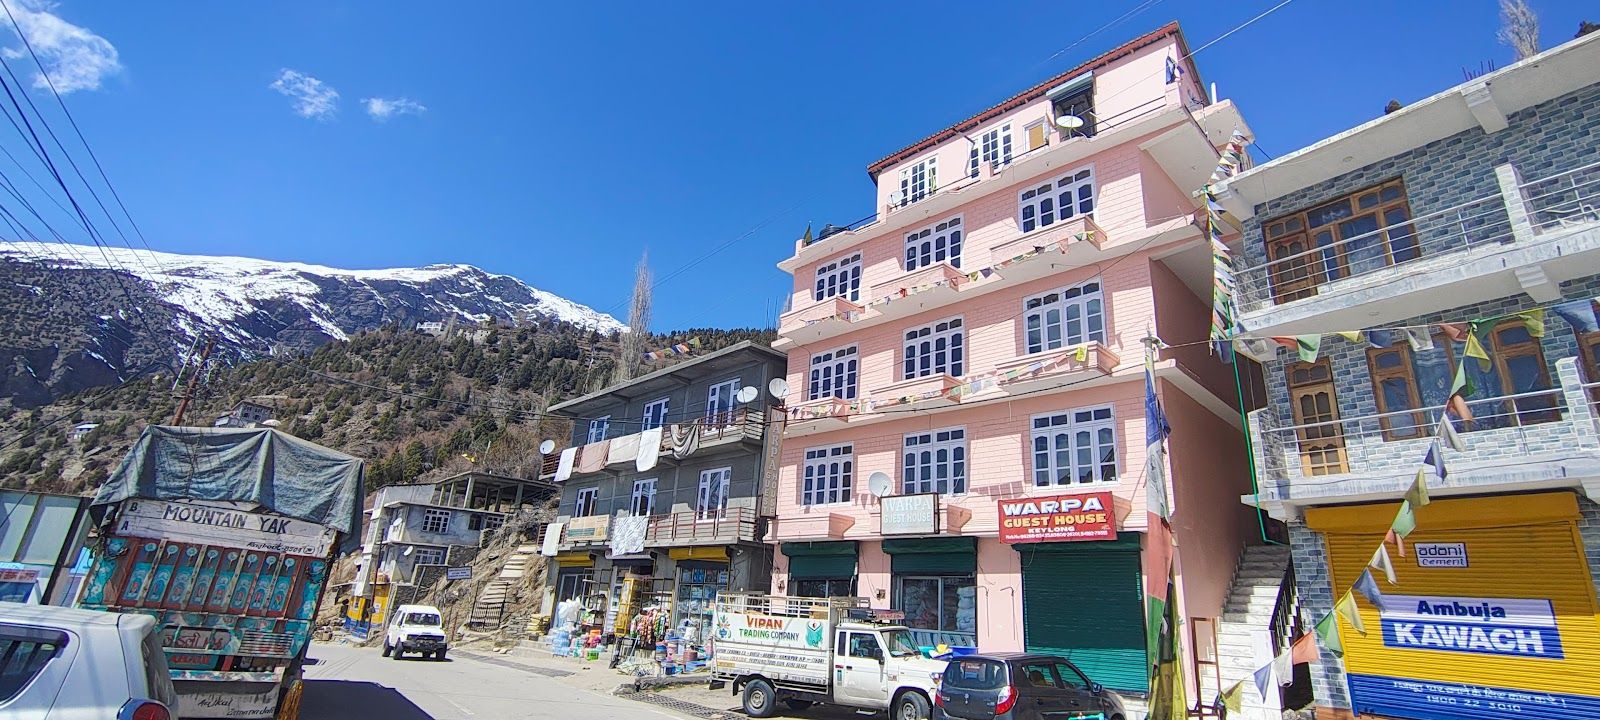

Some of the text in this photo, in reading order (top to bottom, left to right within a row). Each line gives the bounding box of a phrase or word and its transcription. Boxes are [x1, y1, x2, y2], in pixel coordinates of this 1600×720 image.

[129, 502, 138, 511] B
[884, 496, 931, 512] WARPA
[1002, 497, 1104, 516] WARPA
[163, 505, 291, 534] MOUNTAIN YAK
[884, 511, 931, 523] GUEST HOUSE
[1003, 513, 1107, 528] GUEST HOUSE
[1028, 526, 1076, 534] KEYLONG
[1418, 545, 1462, 556] adani
[1422, 558, 1465, 566] cement
[1417, 600, 1506, 621] Ambuja
[746, 615, 783, 629] VIPAN
[739, 628, 799, 641] TRADING COMPANY
[1393, 622, 1545, 654] KAWACH
[1427, 695, 1457, 705] 1800
[1488, 703, 1521, 712] 3010
